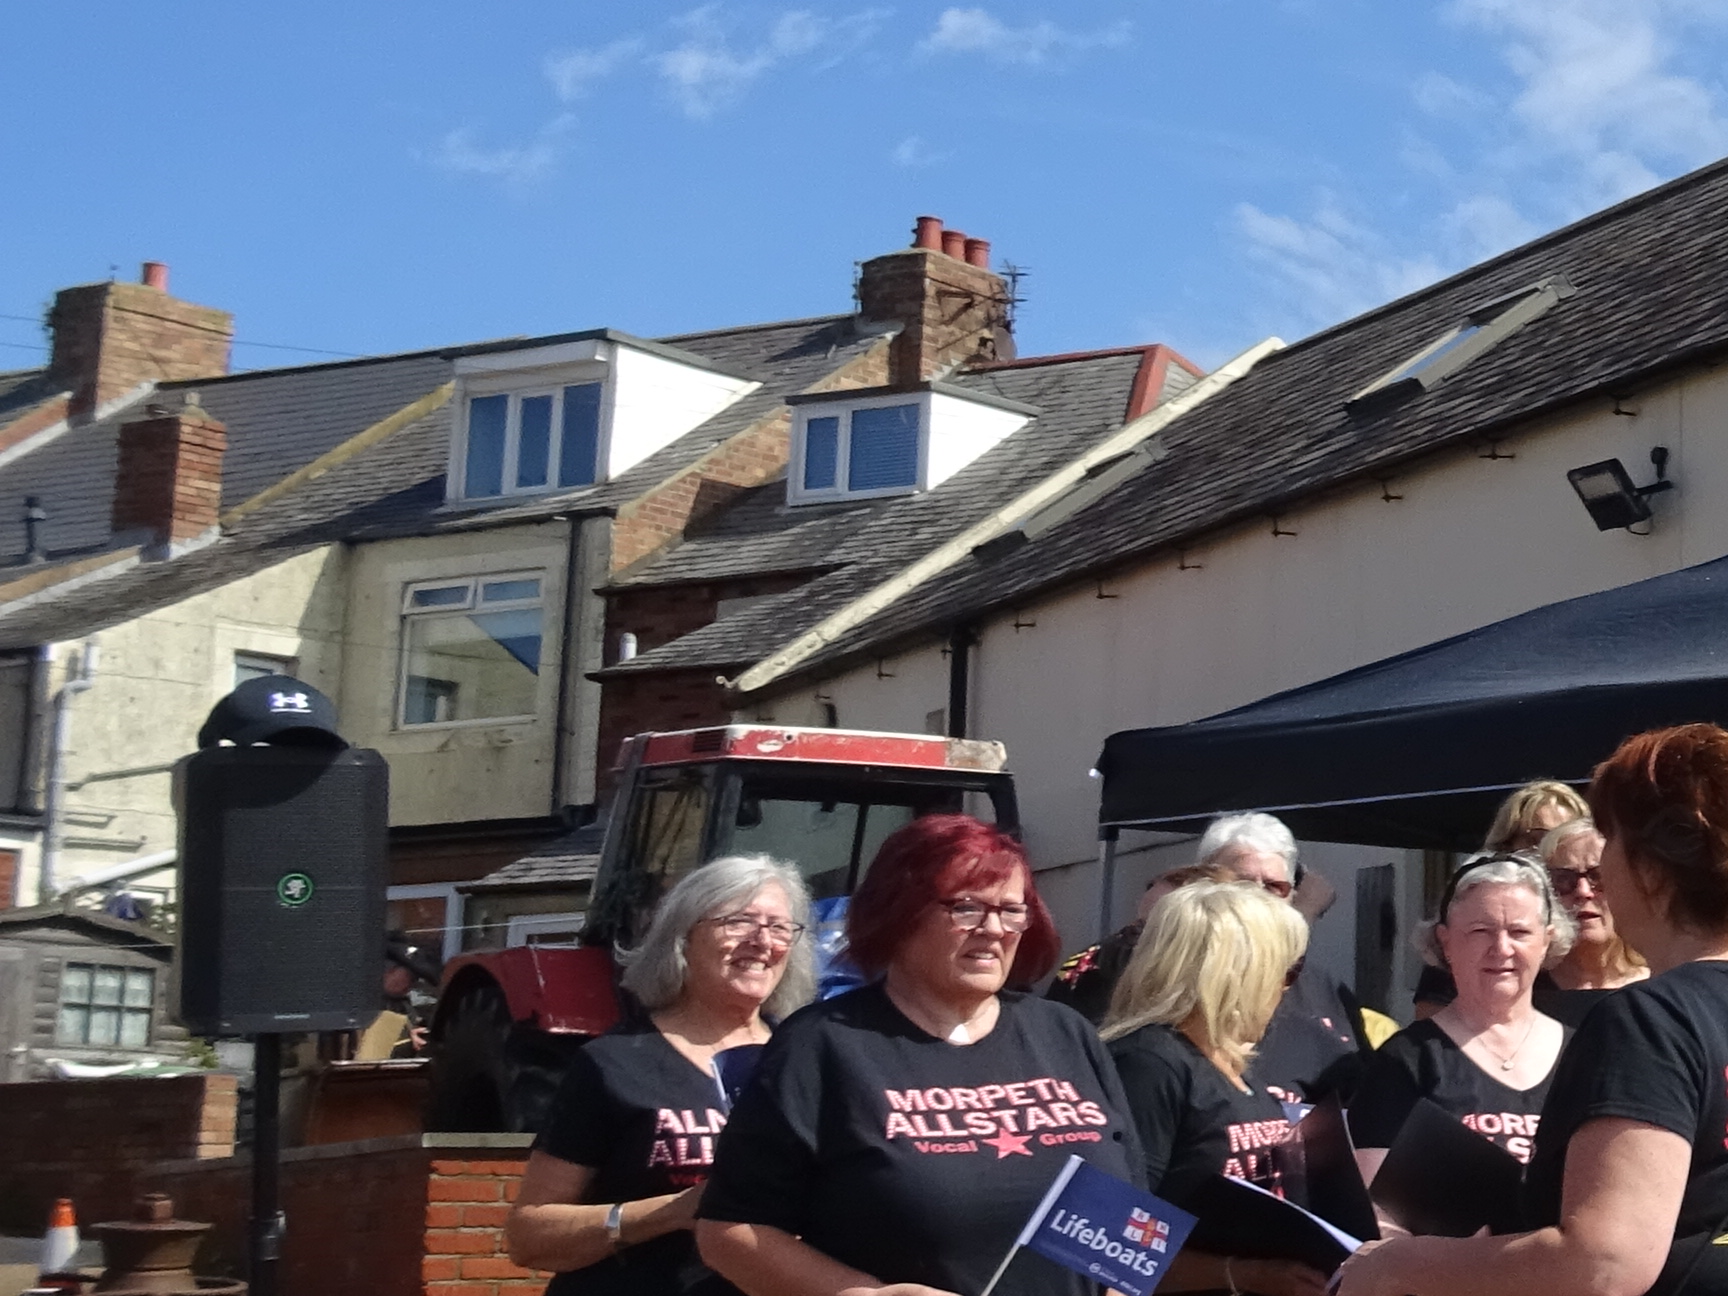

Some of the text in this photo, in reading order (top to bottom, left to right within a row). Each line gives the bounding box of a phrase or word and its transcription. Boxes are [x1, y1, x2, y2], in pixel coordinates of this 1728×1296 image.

[884, 1077, 1081, 1113] MORPETH
[884, 1100, 1108, 1140] ALLSTARS
[913, 1130, 1103, 1154] Vocal Group
[1049, 1208, 1159, 1277] Lifeboats
